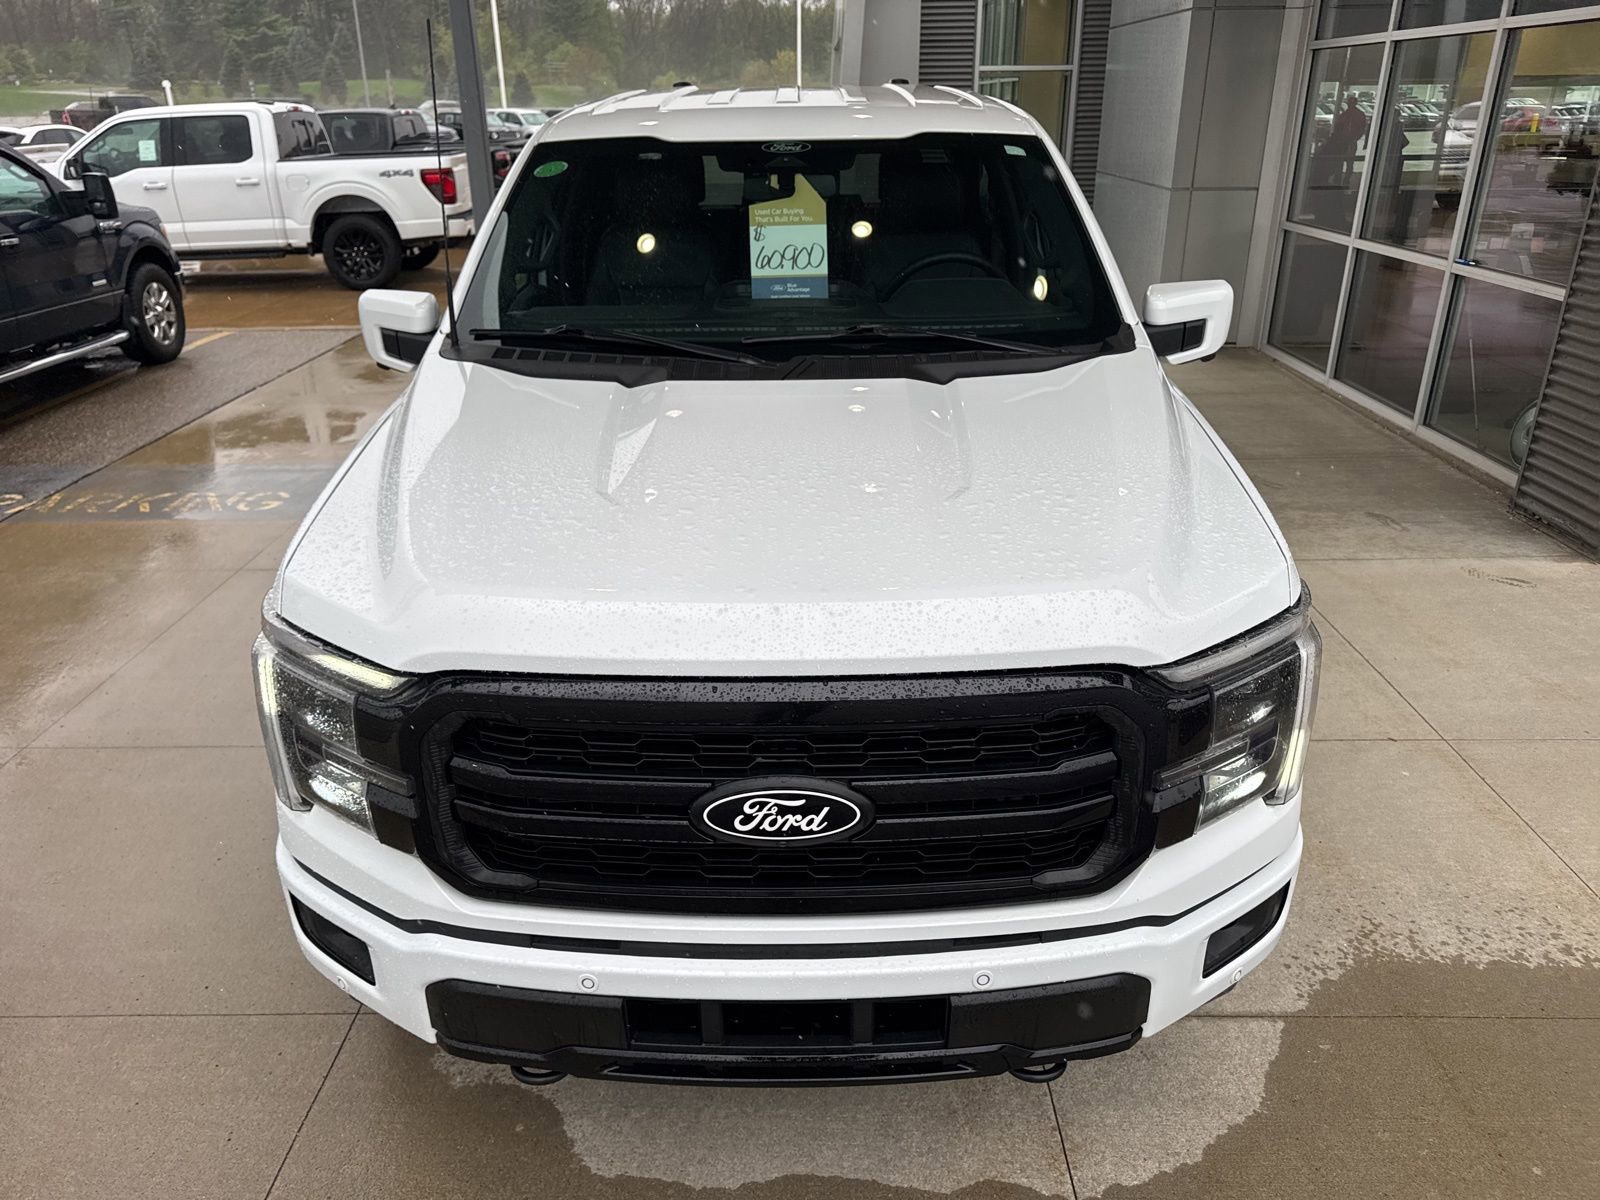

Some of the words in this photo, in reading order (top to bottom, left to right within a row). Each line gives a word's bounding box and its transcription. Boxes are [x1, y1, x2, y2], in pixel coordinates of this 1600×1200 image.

[754, 208, 770, 216] Used
[771, 208, 782, 216] Car
[783, 208, 804, 217] Buying
[755, 215, 774, 223] That's
[774, 215, 788, 223] Built
[734, 797, 830, 832] Ford
